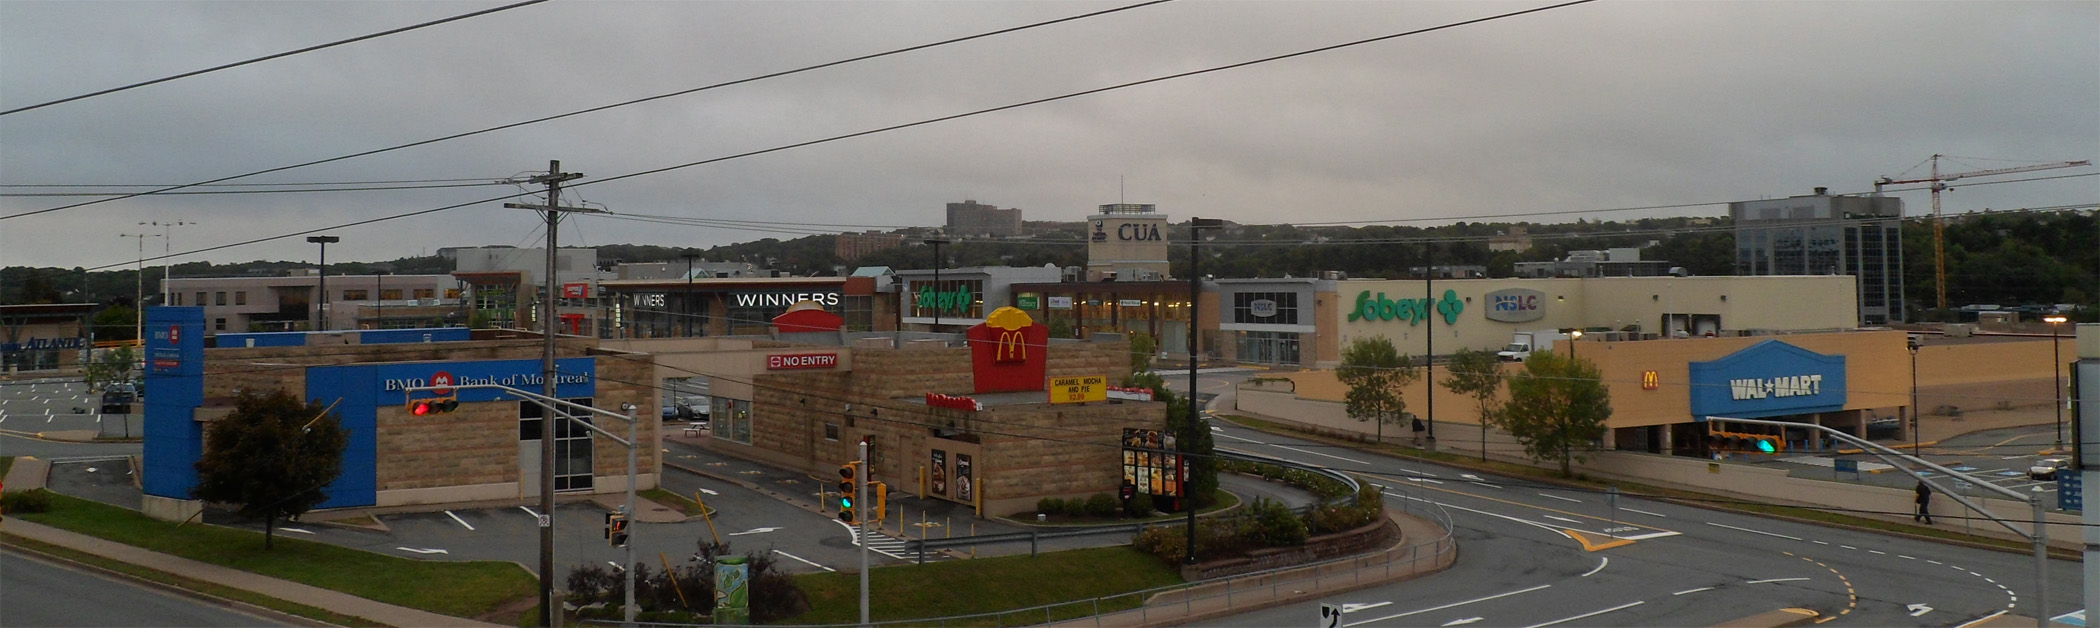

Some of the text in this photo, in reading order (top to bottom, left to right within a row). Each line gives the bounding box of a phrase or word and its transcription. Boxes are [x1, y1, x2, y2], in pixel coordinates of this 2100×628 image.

[1118, 223, 1161, 241] CUA
[633, 294, 665, 307] WNNERS
[736, 292, 839, 307] WINNERS
[917, 285, 955, 313] Sobeys
[1495, 295, 1537, 311] NSLC
[1348, 290, 1435, 326] Sobeys
[783, 355, 836, 366] NO ENTRY
[385, 371, 589, 391] BMO Bank of Motreal
[1054, 377, 1102, 387] CARAMEL MOCHA
